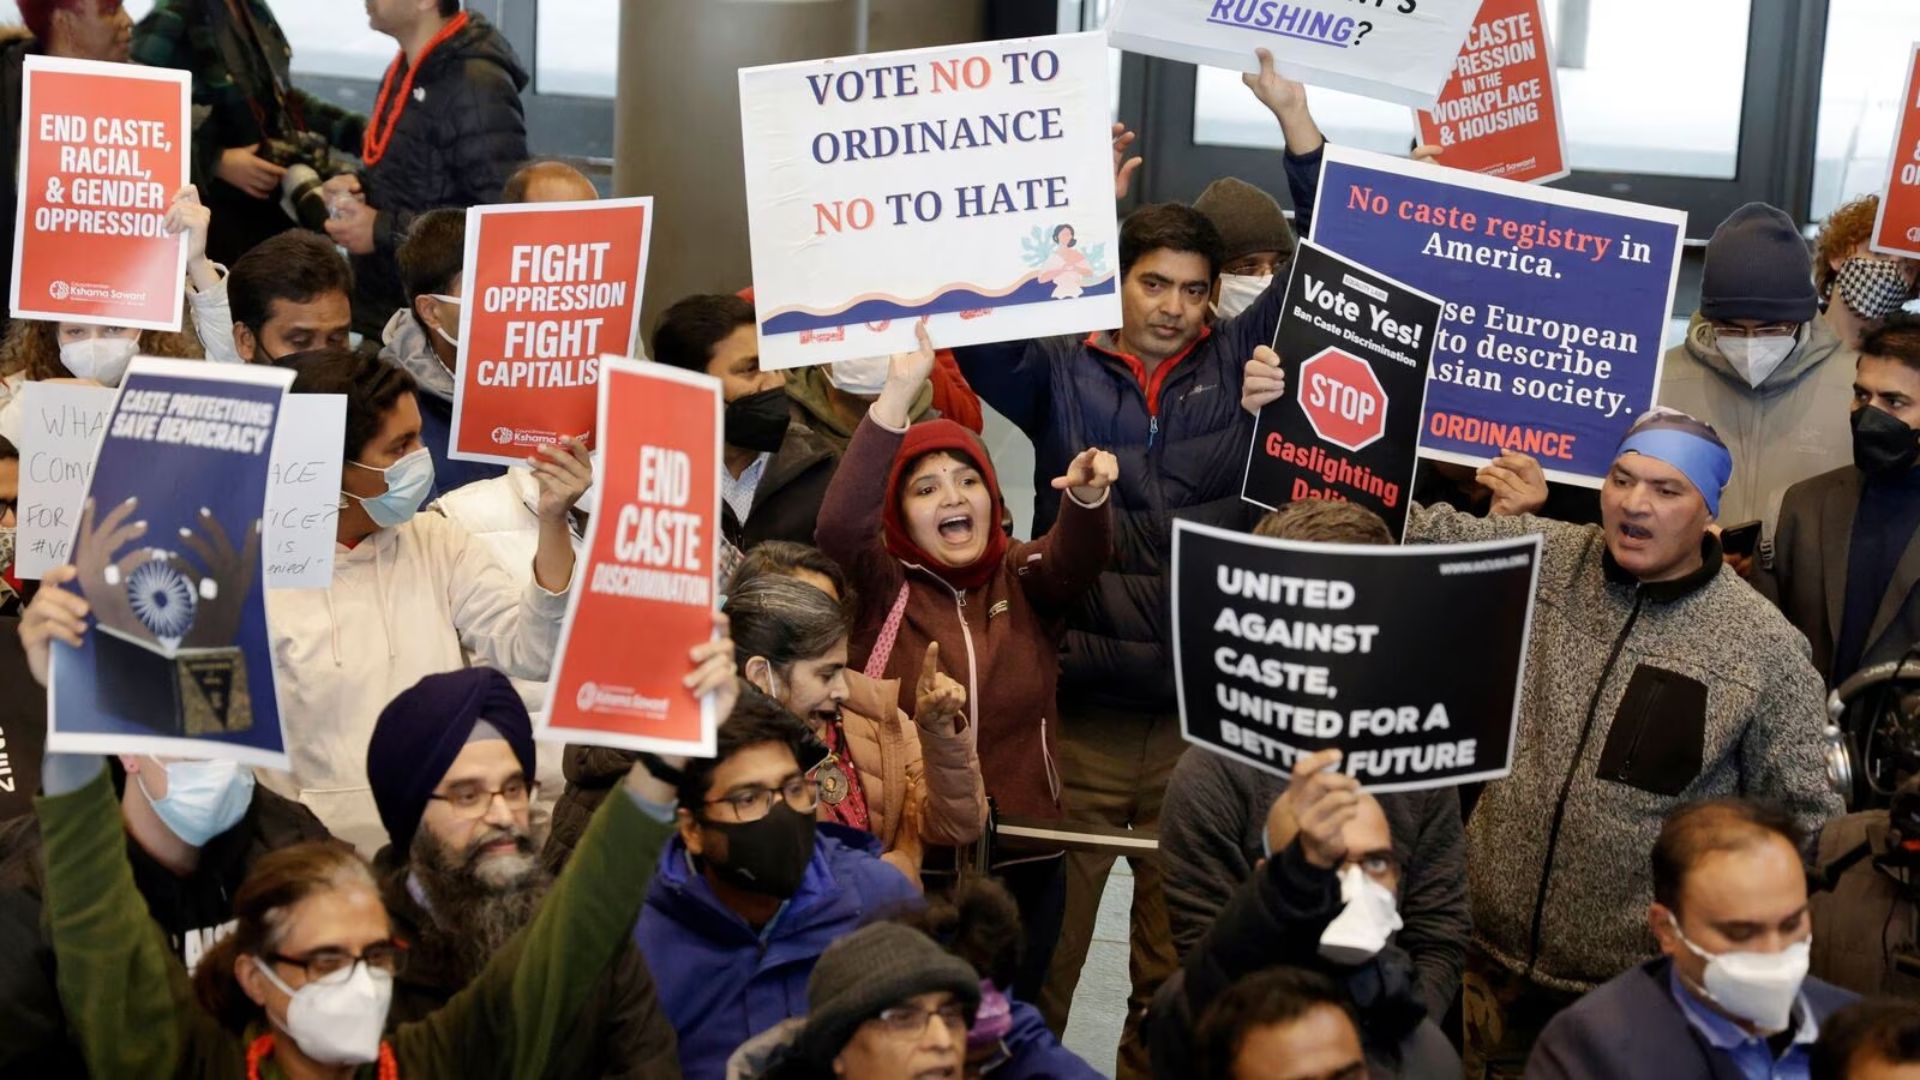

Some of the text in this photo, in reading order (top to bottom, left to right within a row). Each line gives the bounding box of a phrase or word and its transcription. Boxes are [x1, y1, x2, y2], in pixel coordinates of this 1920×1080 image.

[806, 50, 1059, 105] VOTE NO TO
[1462, 71, 1503, 95] IN THE
[1432, 78, 1541, 125] WORKPLACE
[1440, 102, 1539, 147] & HOUSING
[40, 113, 172, 152] END CASTE,
[812, 107, 1063, 164] ORDINANCE
[60, 145, 151, 180] RACIAL,
[45, 176, 164, 209] & GENDER
[813, 176, 1069, 235] NO TO HATE
[1347, 185, 1651, 263] No caste registry in
[511, 242, 610, 283] FIGHT
[1421, 231, 1562, 280] America.
[70, 285, 109, 297] Kshama
[484, 281, 626, 312] OPPRESSION
[1304, 274, 1423, 349] Vote Yes!
[504, 317, 604, 358] FIGHT
[1293, 305, 1416, 368] Ban Caste Discrimination
[1440, 301, 1639, 354] se European
[477, 358, 599, 388] CAPITALIS
[1437, 328, 1612, 379] to describe
[120, 389, 274, 427] CASTE PROTECTIONS
[1309, 373, 1376, 425] STOP
[1512, 376, 1633, 418] society.
[41, 404, 108, 438] WHA
[110, 412, 270, 456] SAVE DEMOCRACY
[514, 432, 556, 444] Kshama
[1430, 412, 1576, 460] ORDINANCE
[638, 445, 690, 507] END
[1265, 432, 1399, 508] Gaslighting
[614, 504, 702, 570] CASTE
[590, 562, 710, 606] DISCRIMINATION
[1216, 564, 1356, 610] UNITED
[1213, 607, 1379, 654] AGAINST
[1214, 646, 1338, 699] CASTE,
[1216, 683, 1450, 739] UNITED FOR A
[1346, 739, 1478, 778] FUTURE
